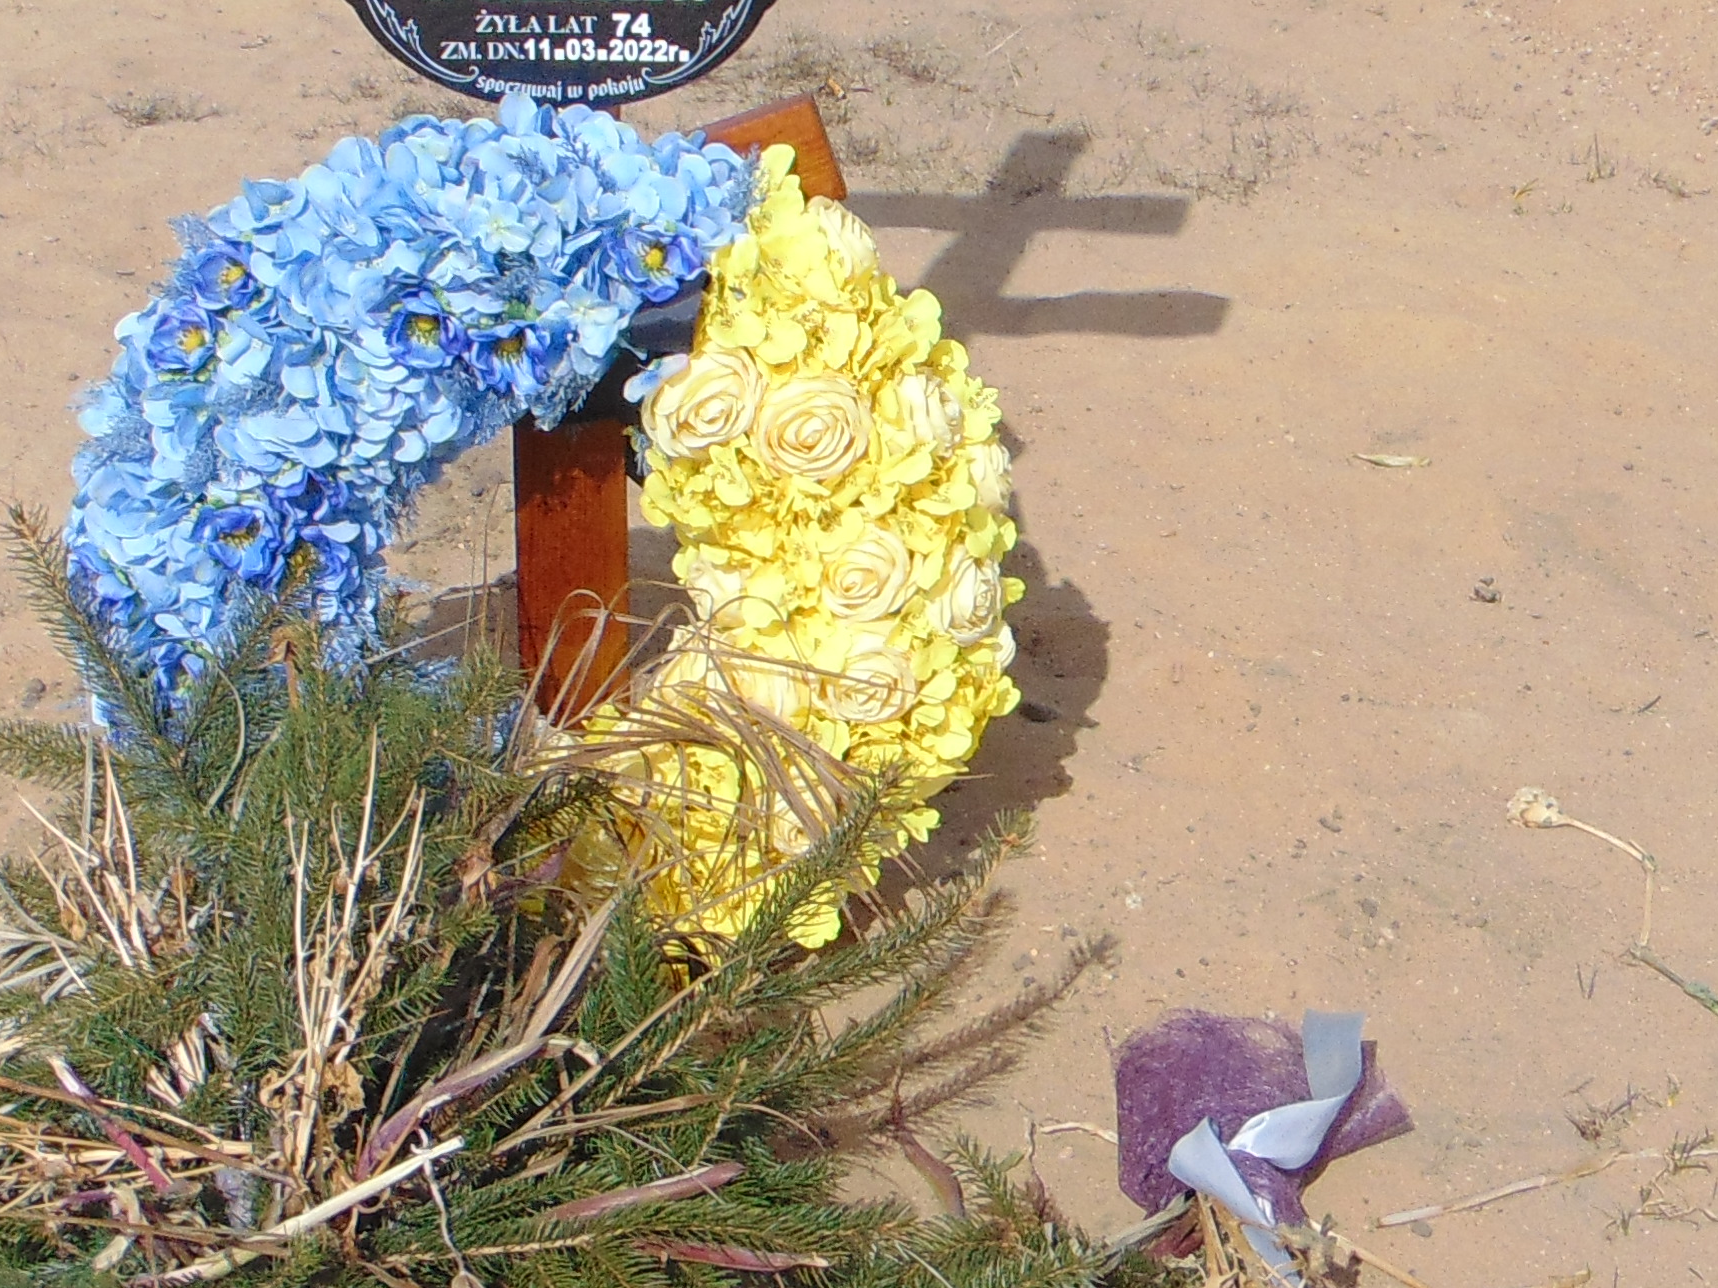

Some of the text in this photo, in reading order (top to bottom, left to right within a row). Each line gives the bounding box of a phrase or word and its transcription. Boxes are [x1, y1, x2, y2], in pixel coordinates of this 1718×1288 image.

[475, 9, 652, 38] ŻYŁA LAT 74
[440, 41, 482, 62] ZM.
[474, 73, 647, 102] spoczywaj w pokoju
